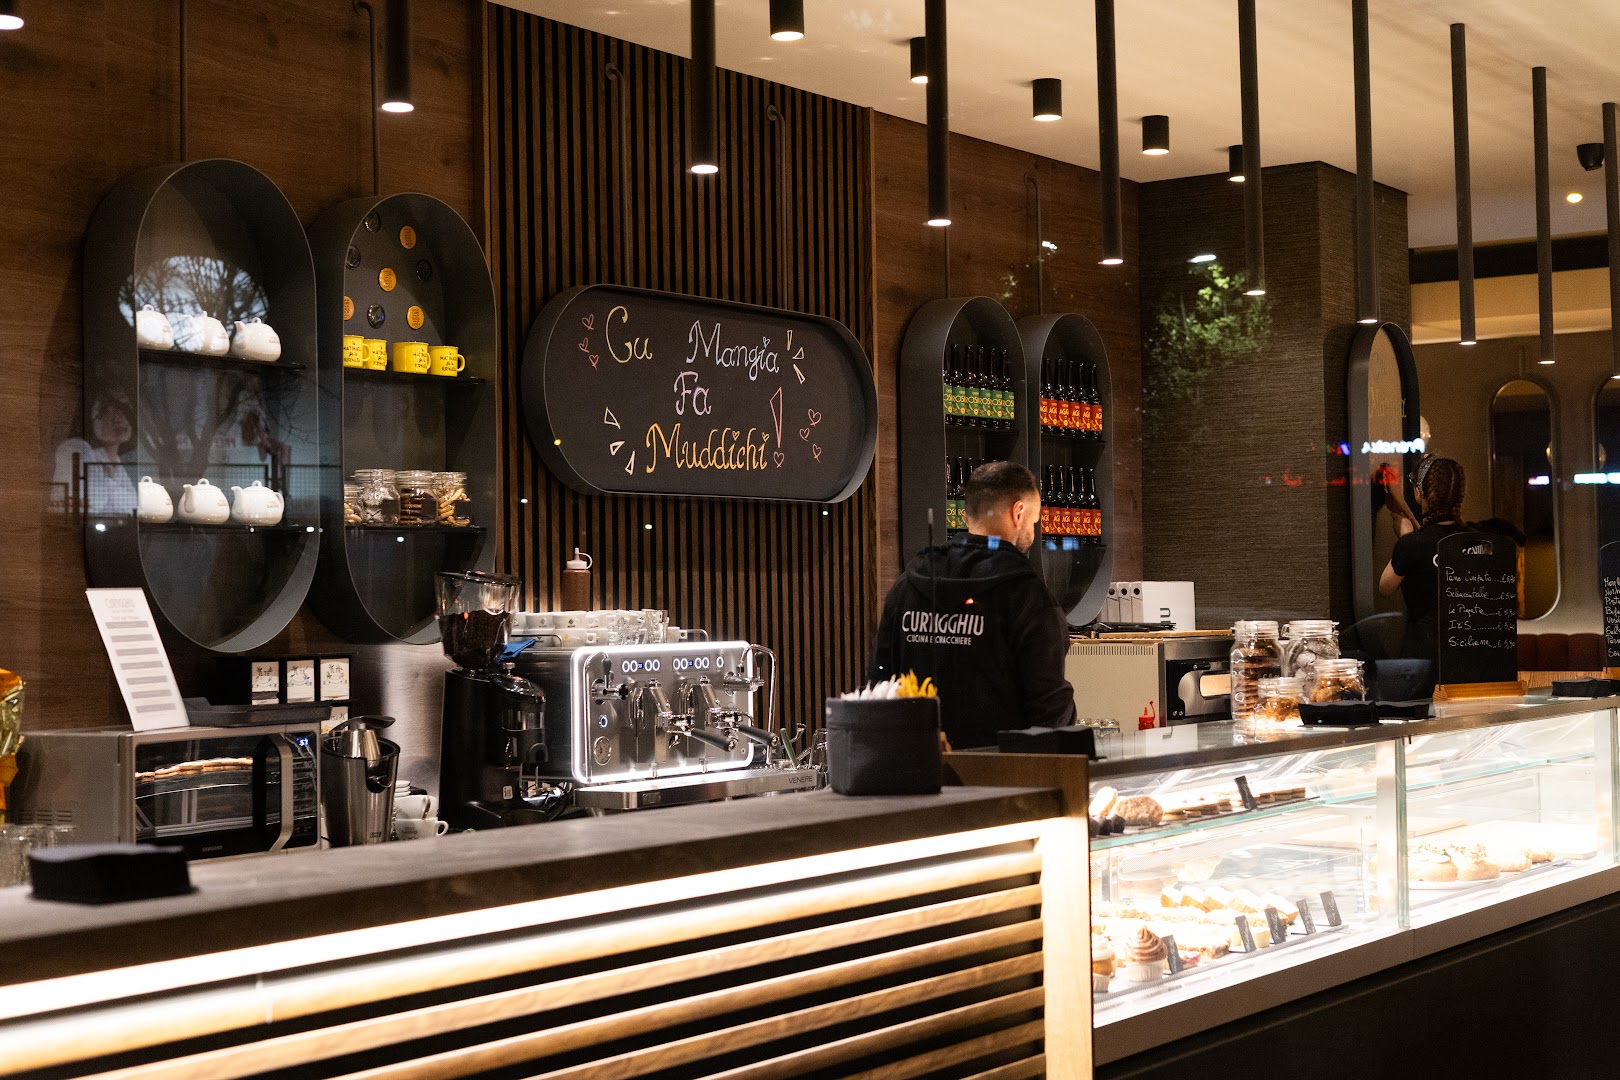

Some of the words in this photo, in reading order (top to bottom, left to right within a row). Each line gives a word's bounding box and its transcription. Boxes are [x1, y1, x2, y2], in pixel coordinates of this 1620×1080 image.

[686, 319, 780, 381] Mangia
[673, 370, 712, 416] Fa
[906, 634, 929, 643] CUCINA
[788, 775, 813, 784] VENERE
